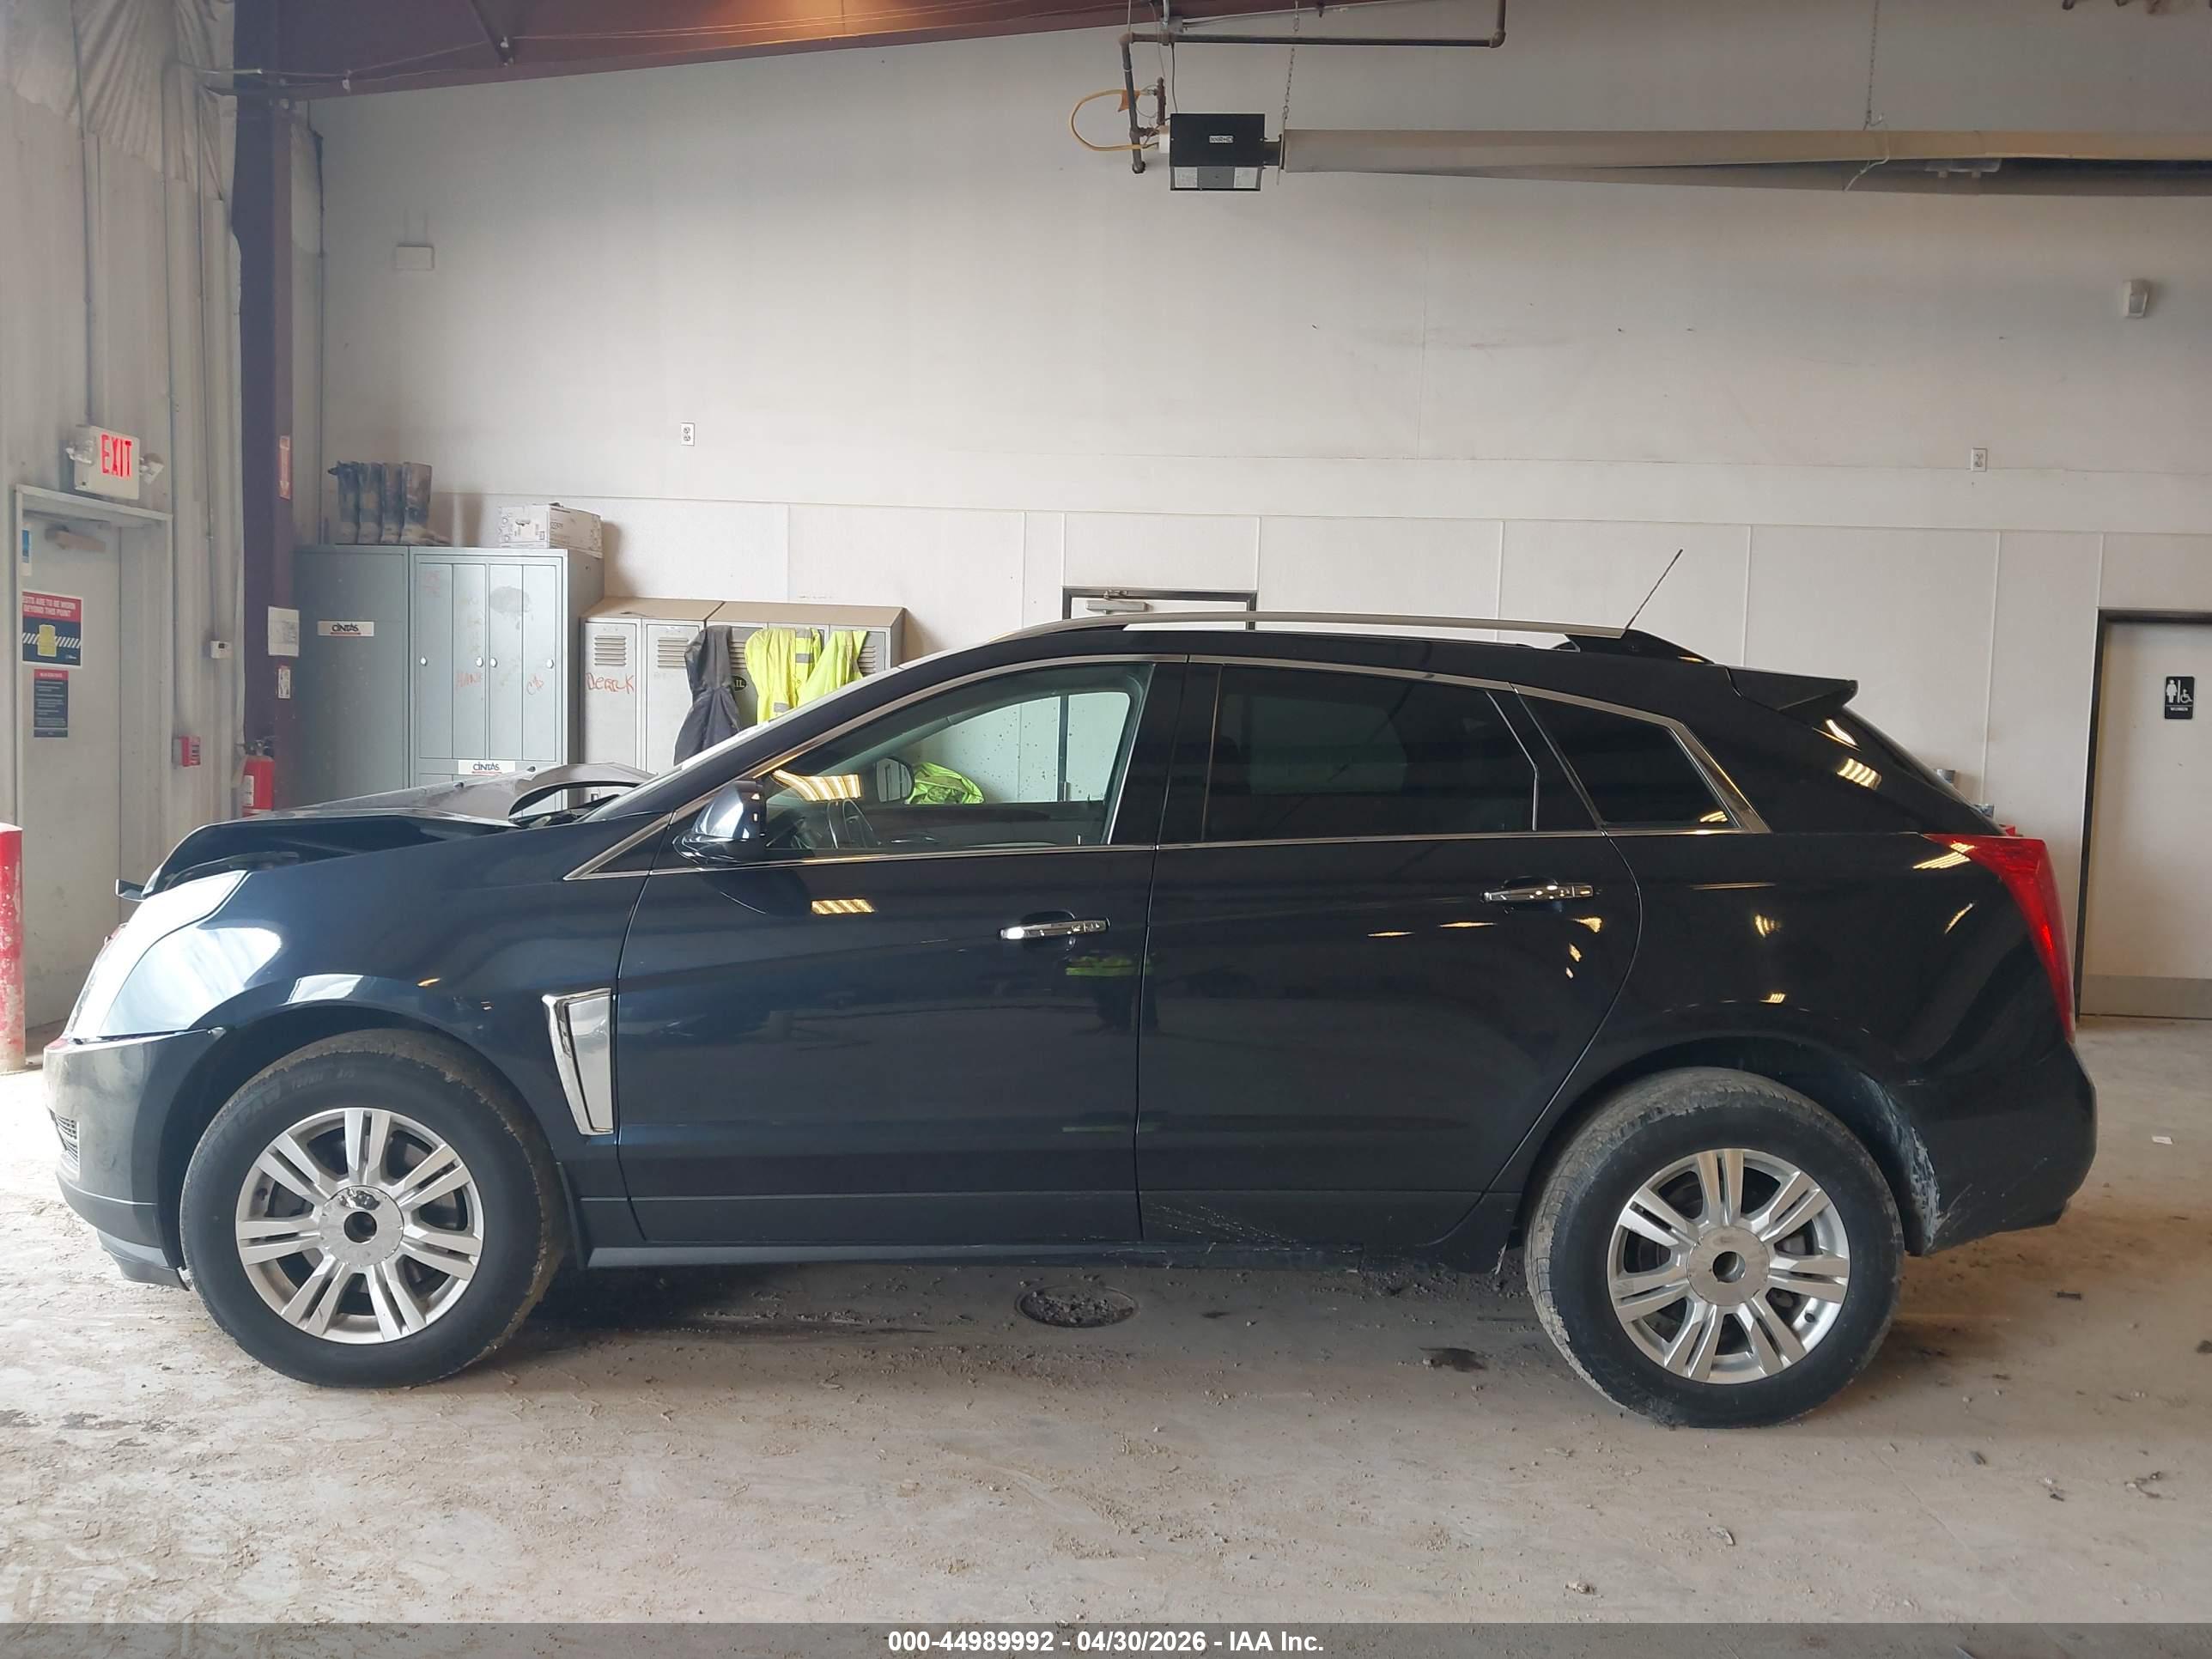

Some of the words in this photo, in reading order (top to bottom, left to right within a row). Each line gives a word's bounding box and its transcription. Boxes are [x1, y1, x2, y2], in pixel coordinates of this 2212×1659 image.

[101, 434, 132, 477] EXIT
[331, 623, 359, 632] CINTAS
[473, 762, 500, 771] CINTAS
